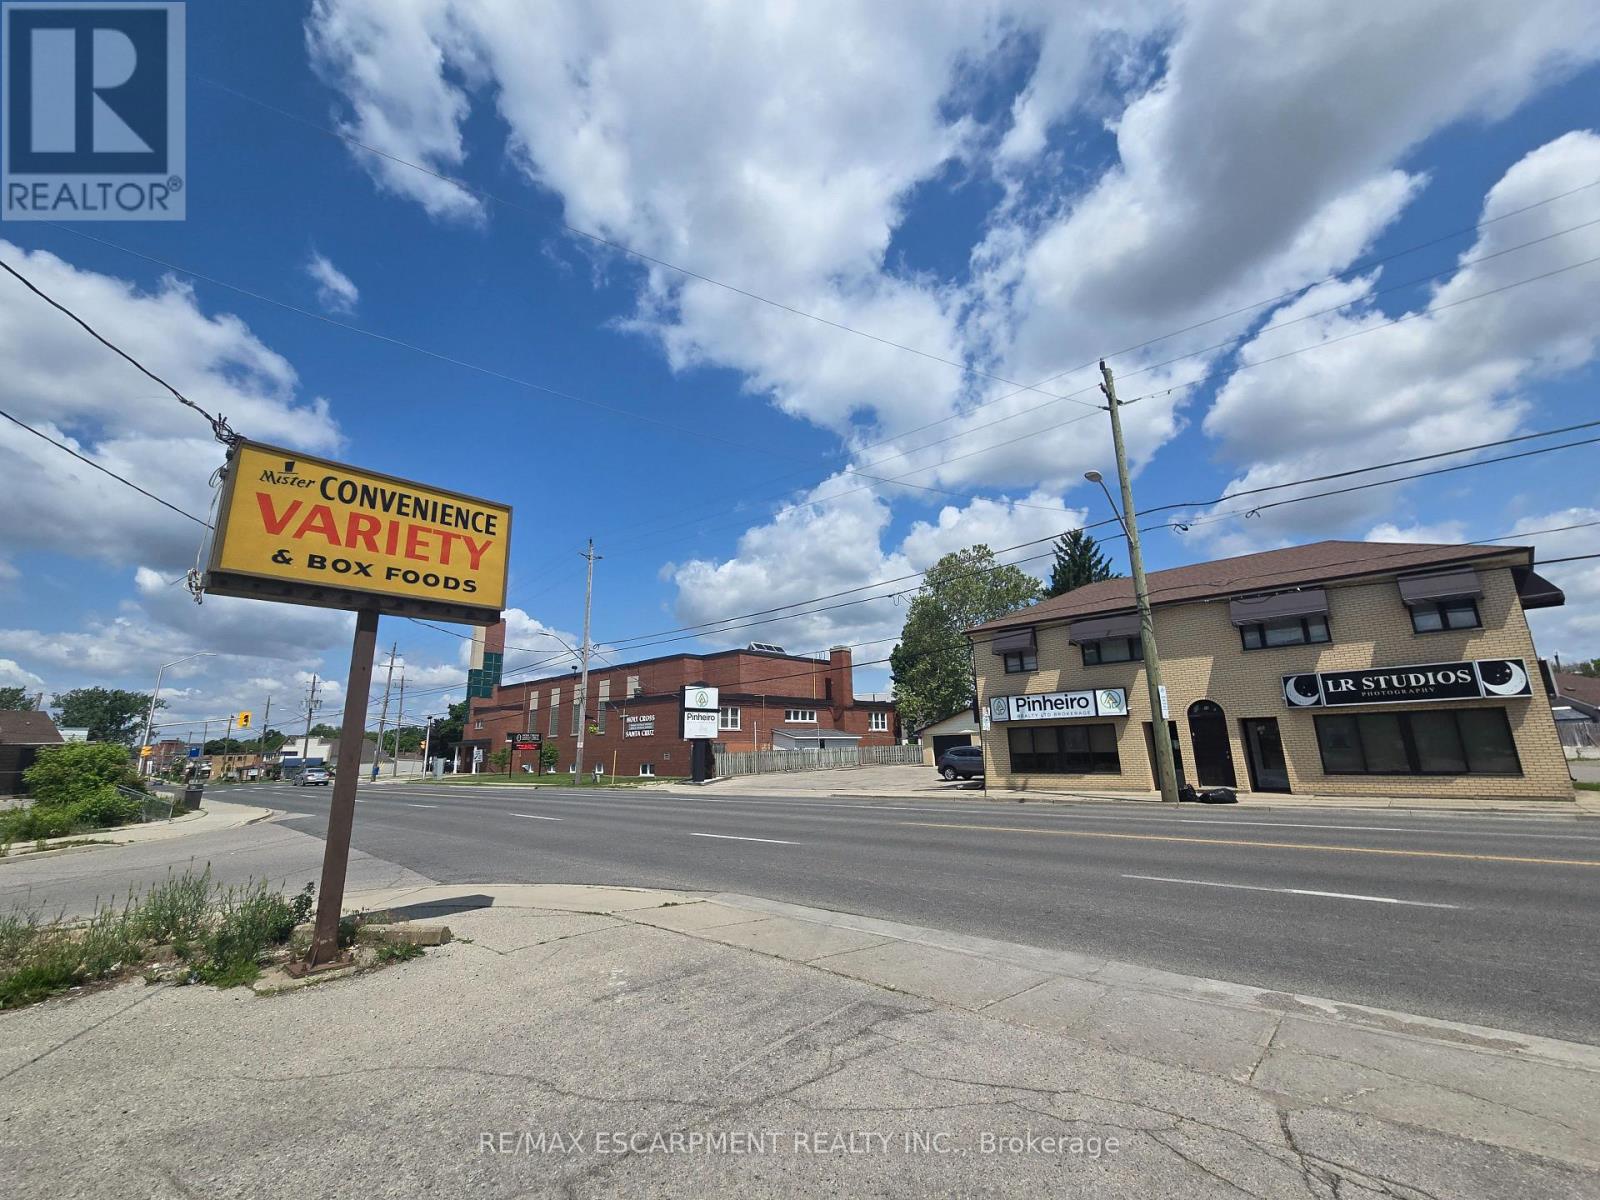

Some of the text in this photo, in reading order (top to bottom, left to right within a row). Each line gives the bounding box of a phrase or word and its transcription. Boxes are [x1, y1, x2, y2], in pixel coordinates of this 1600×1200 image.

[259, 469, 498, 536] Mister CONVENIENCE
[256, 492, 493, 571] VARIETY
[271, 549, 478, 593] & BOX FOODS
[1326, 669, 1472, 693] LR STUDIOS
[1361, 687, 1435, 697] PHOTOGRAPHY
[1016, 694, 1090, 712] Pinheiro
[686, 712, 716, 721] Pinheiro
[641, 729, 655, 737] CRUZ
